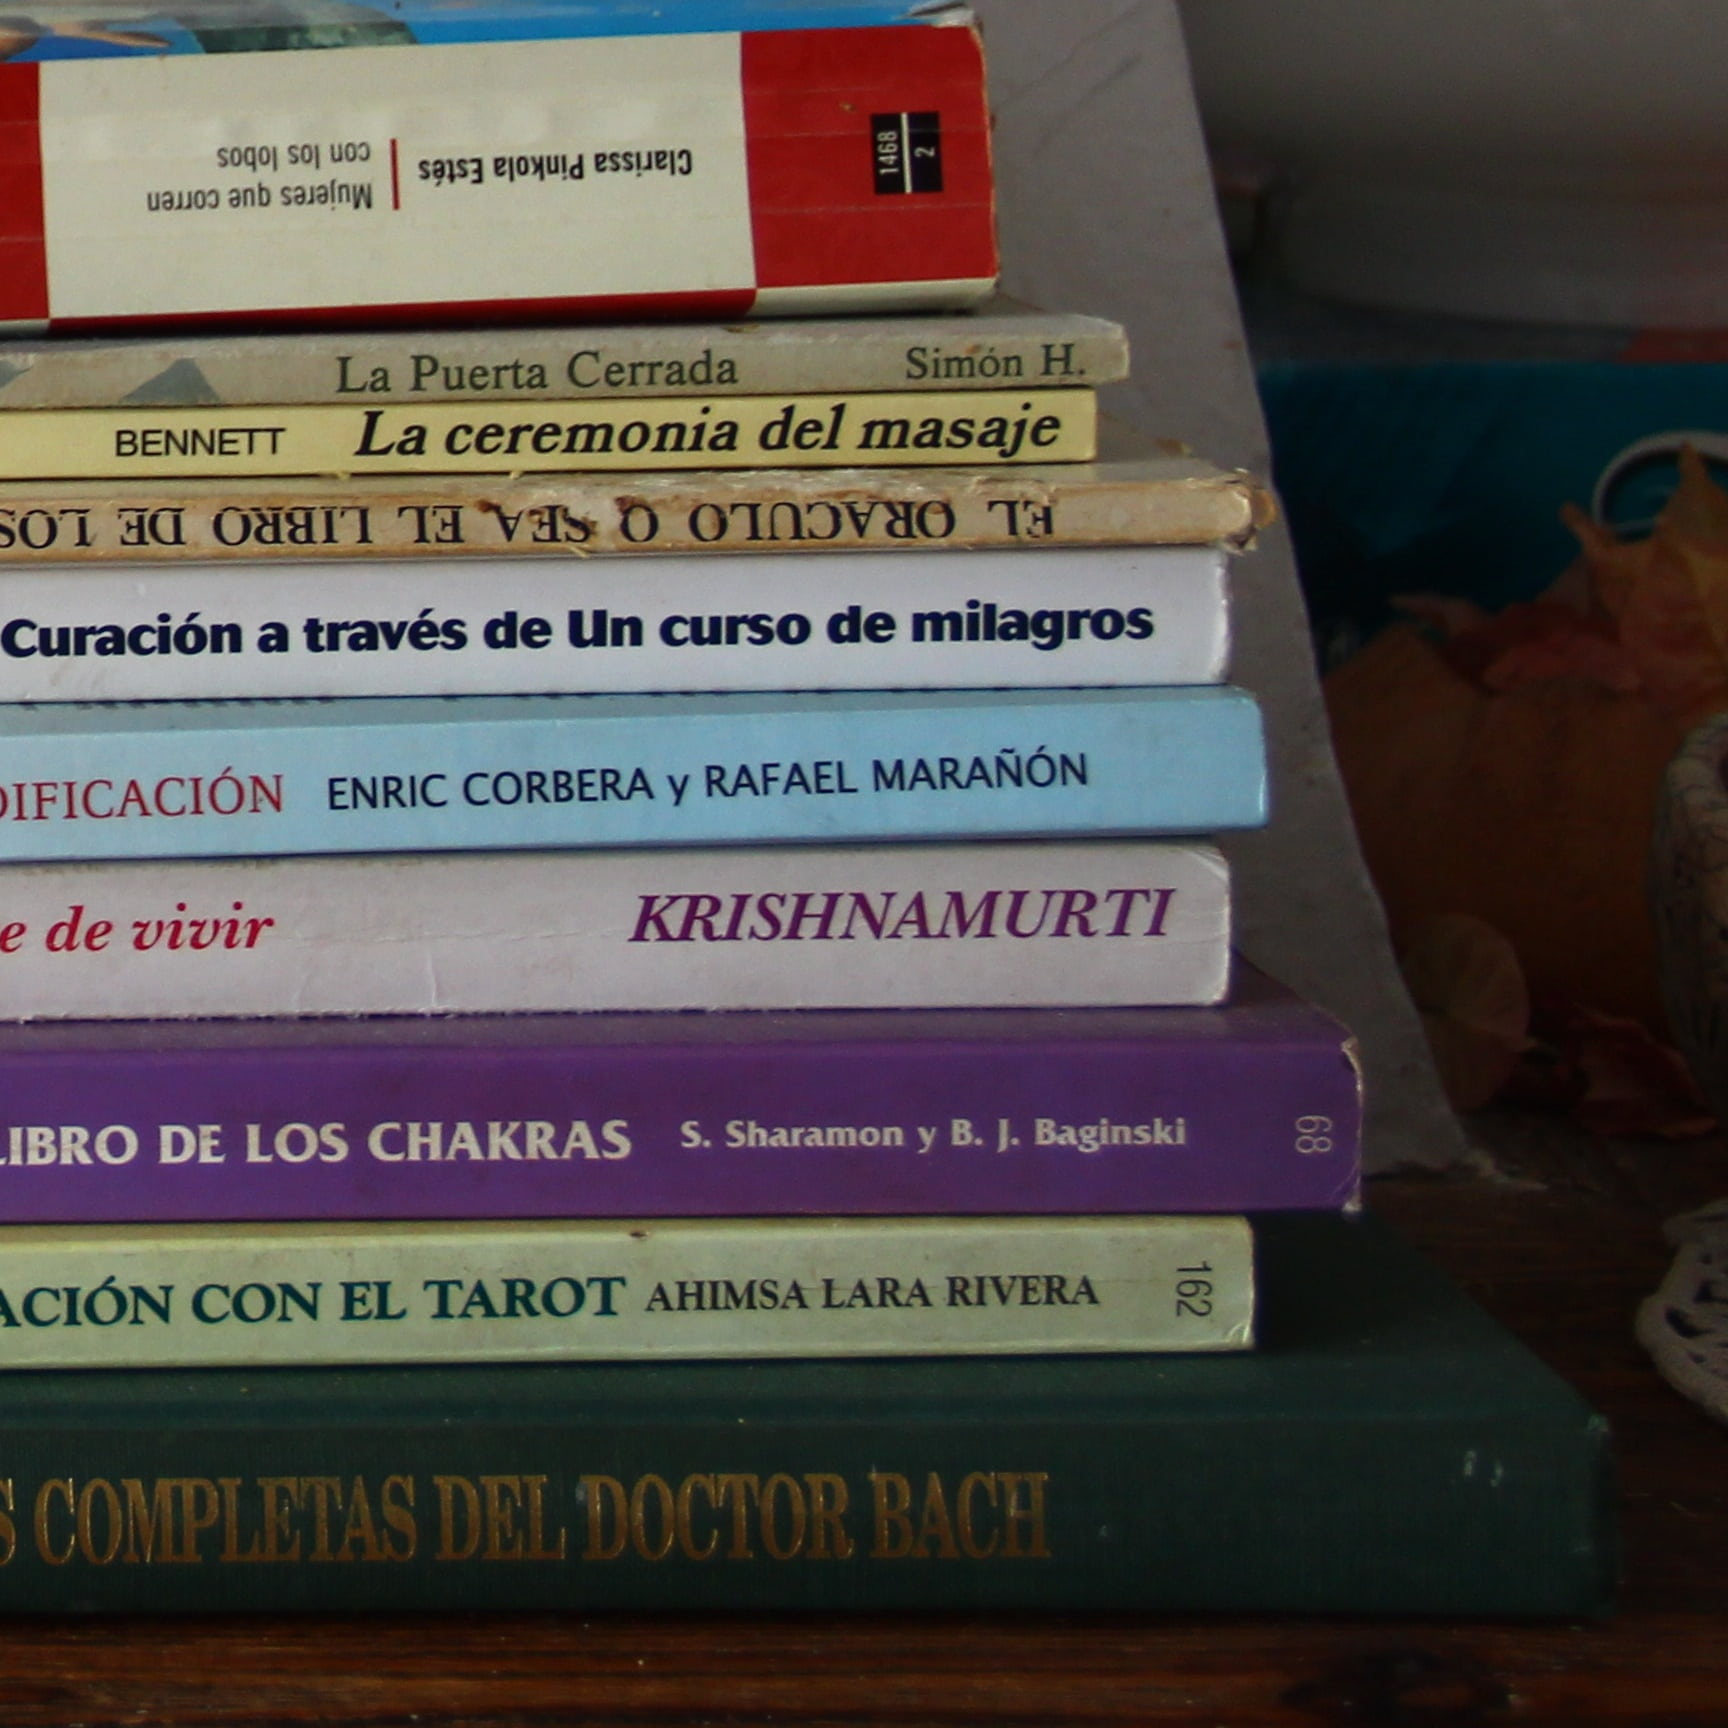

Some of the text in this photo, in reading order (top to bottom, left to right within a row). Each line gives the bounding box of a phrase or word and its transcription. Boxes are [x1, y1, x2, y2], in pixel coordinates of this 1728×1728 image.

[216, 141, 371, 173] con los lobos
[418, 148, 693, 187] Clarissa Pinkola Estés
[877, 130, 899, 175] 1468
[913, 146, 936, 158] 2
[146, 178, 373, 212] Mujeres que corren
[335, 348, 739, 394] La Puerta Cerrada
[905, 343, 1086, 381] Simón H.
[115, 427, 287, 458] BENNETT
[353, 402, 1061, 458] La ceremonia del masaje
[117, 507, 187, 546] DE
[212, 505, 373, 547] LIBRO
[397, 505, 465, 544] EL
[618, 502, 660, 543] O
[688, 500, 956, 543] ORACULO
[987, 499, 1054, 539] EL
[0, 598, 1155, 659] Curación a través de Un curso de milagros
[328, 744, 1088, 811] ENRIC CORBERA y RAFAEL MARAÑÓN
[45, 904, 114, 953] de
[131, 901, 275, 951] vivir
[627, 888, 1177, 942] KRISHNAMURTI
[159, 1124, 226, 1164] DE
[246, 1122, 350, 1164] LOS
[367, 1119, 632, 1162] CHAKRAS
[680, 1117, 1186, 1154] S. Sharamon y B. J. Baginski
[1294, 1114, 1333, 1155] 68
[191, 1282, 323, 1325] CON
[339, 1280, 408, 1321] EL
[423, 1276, 627, 1320] TAROT
[645, 1274, 1100, 1312] AHIMSA LARA RIVERA
[1175, 1261, 1213, 1318] 162
[34, 1474, 417, 1564] COMPLETAS
[432, 1473, 567, 1560] DEL
[577, 1472, 854, 1559] DOCTOR
[866, 1466, 1050, 1557] BACH
